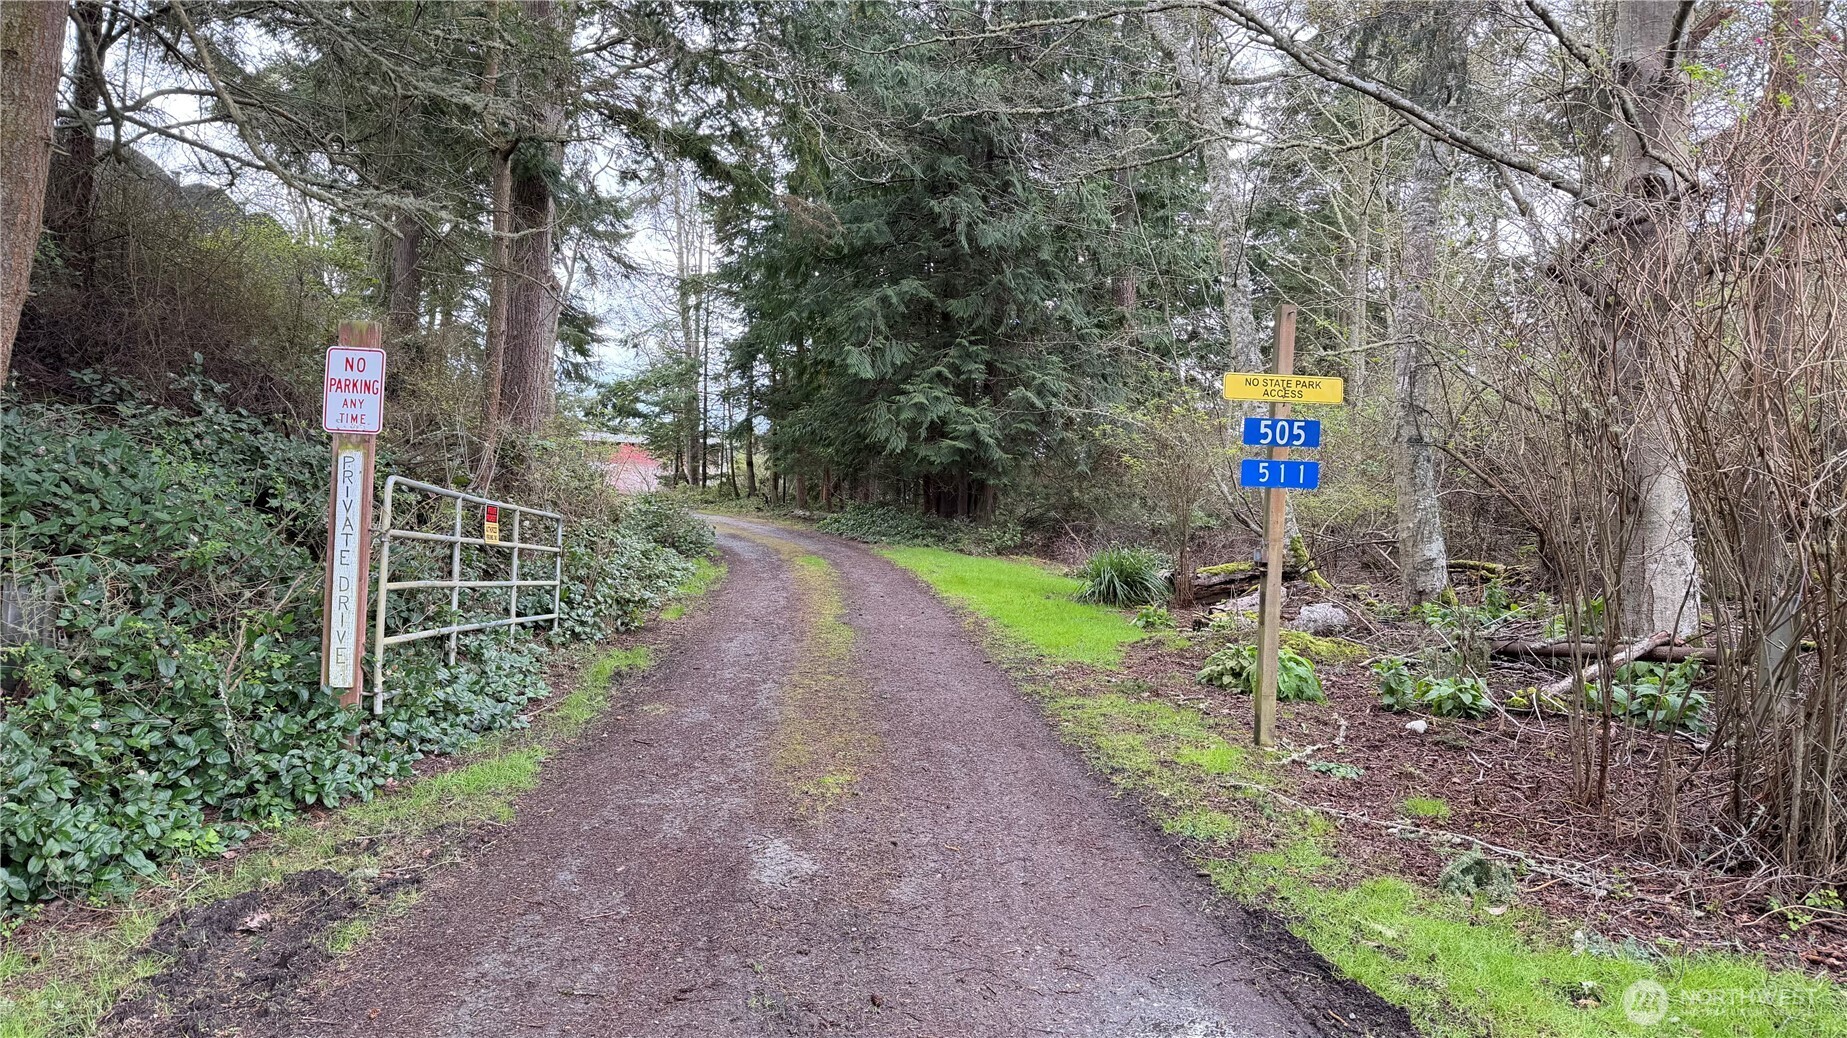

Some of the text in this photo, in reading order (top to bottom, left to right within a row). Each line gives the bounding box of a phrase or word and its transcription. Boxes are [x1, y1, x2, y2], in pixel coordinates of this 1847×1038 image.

[345, 357, 366, 373] NO
[329, 378, 379, 395] PARKING
[1245, 377, 1322, 390] NO STATE PARK
[1262, 389, 1304, 399] ACCESS
[342, 398, 365, 409] ANY
[339, 412, 366, 424] TIME
[1259, 420, 1306, 446] 505
[1258, 462, 1305, 484] 511
[336, 455, 355, 665] PRIVATE DRIVE
